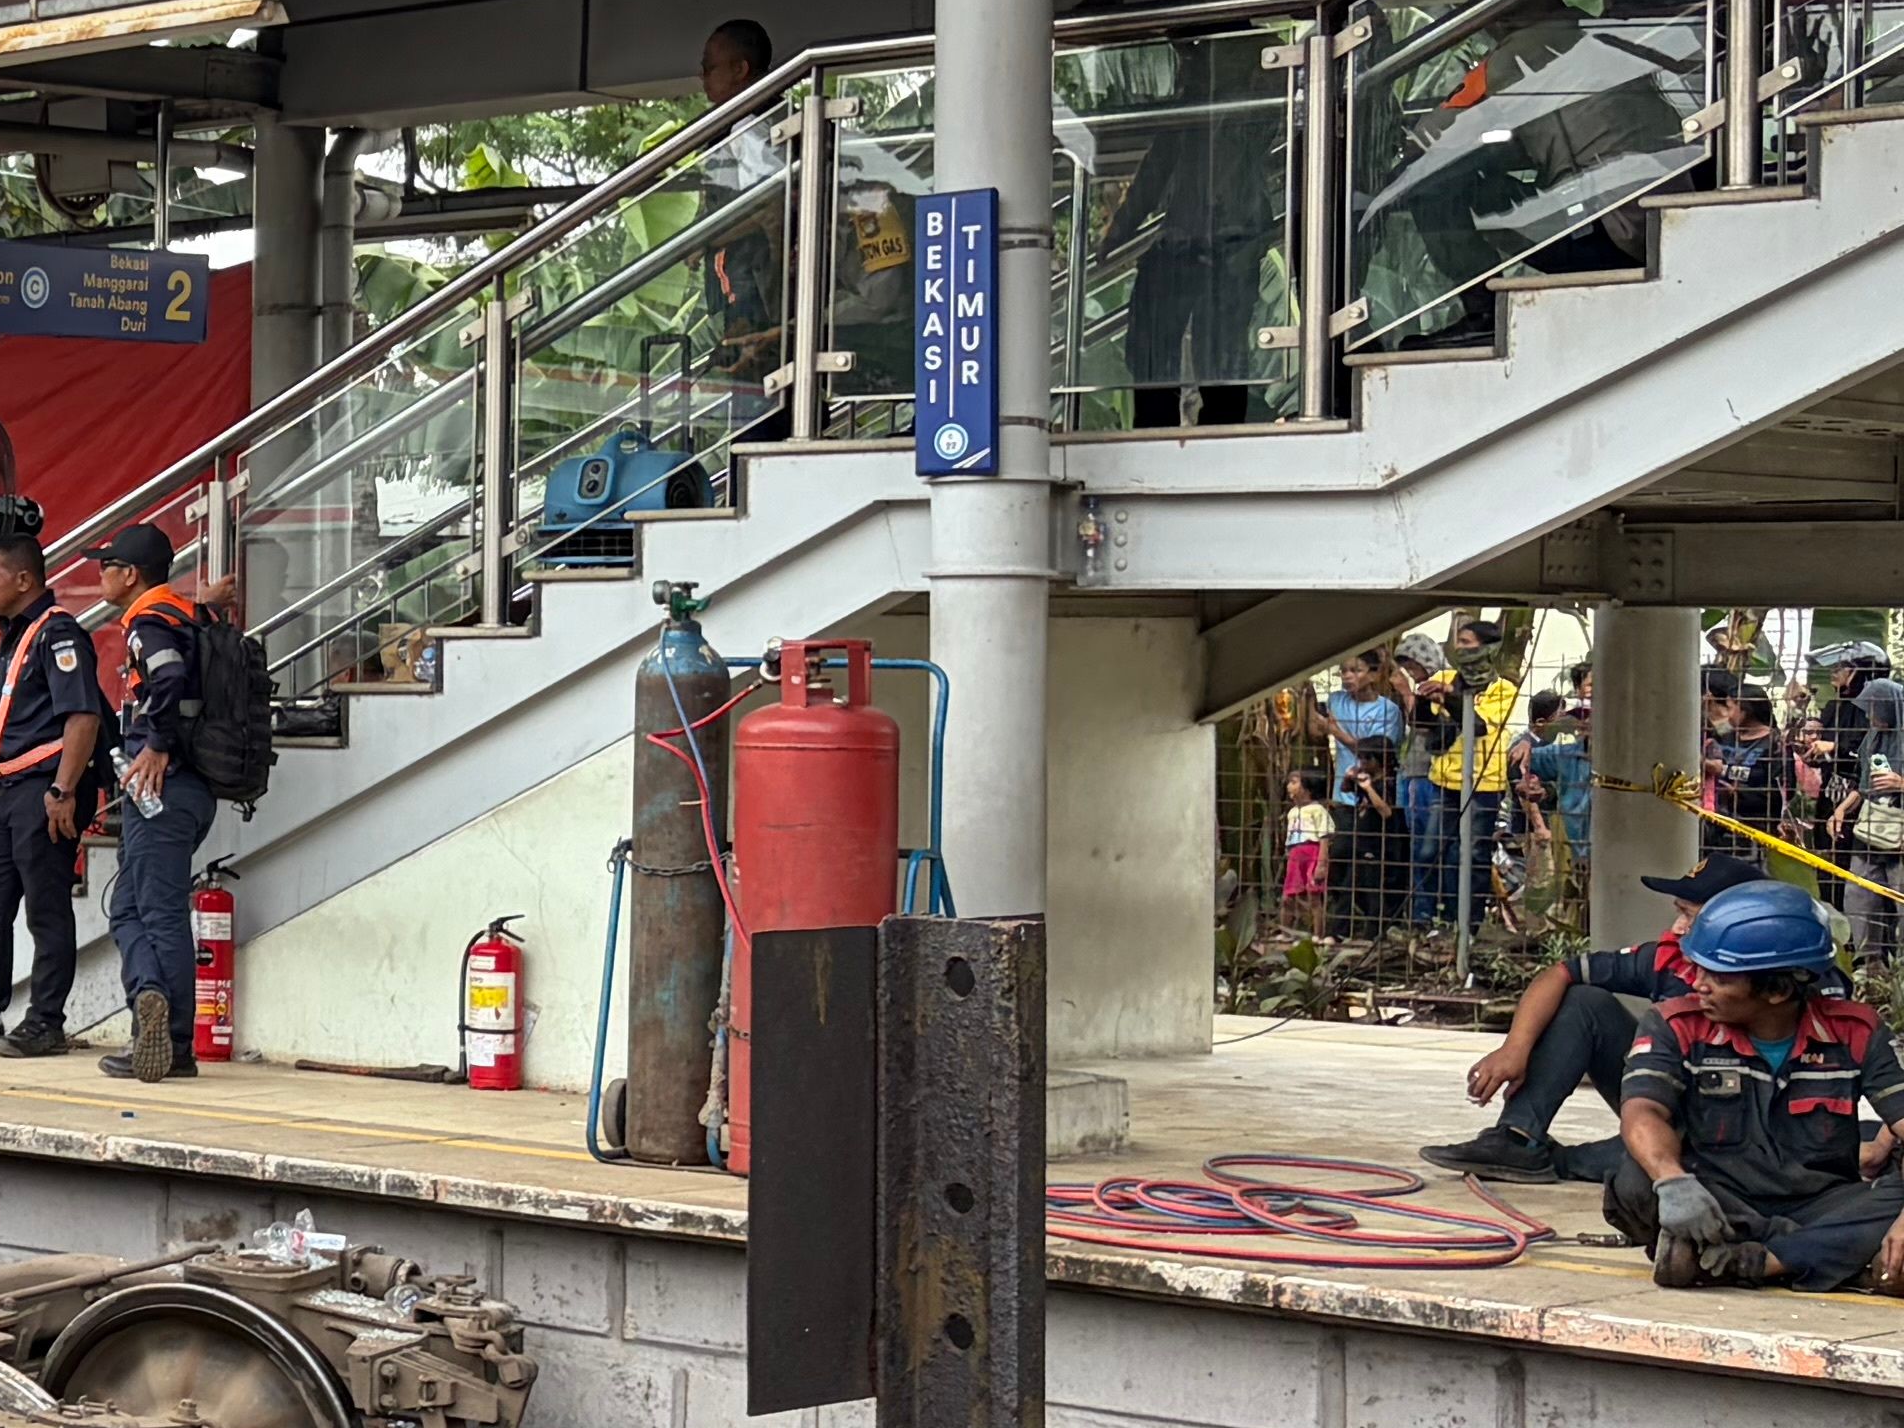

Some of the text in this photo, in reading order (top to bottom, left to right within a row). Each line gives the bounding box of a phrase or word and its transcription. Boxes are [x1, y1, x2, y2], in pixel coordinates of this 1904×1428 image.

[110, 254, 149, 271] Bekasi
[83, 273, 149, 292] Manggarai
[68, 292, 148, 316] Tanah Abang
[164, 269, 192, 322] 2
[922, 211, 945, 404] BEKASI
[957, 224, 984, 385] TIMUR
[120, 316, 147, 333] Duri
